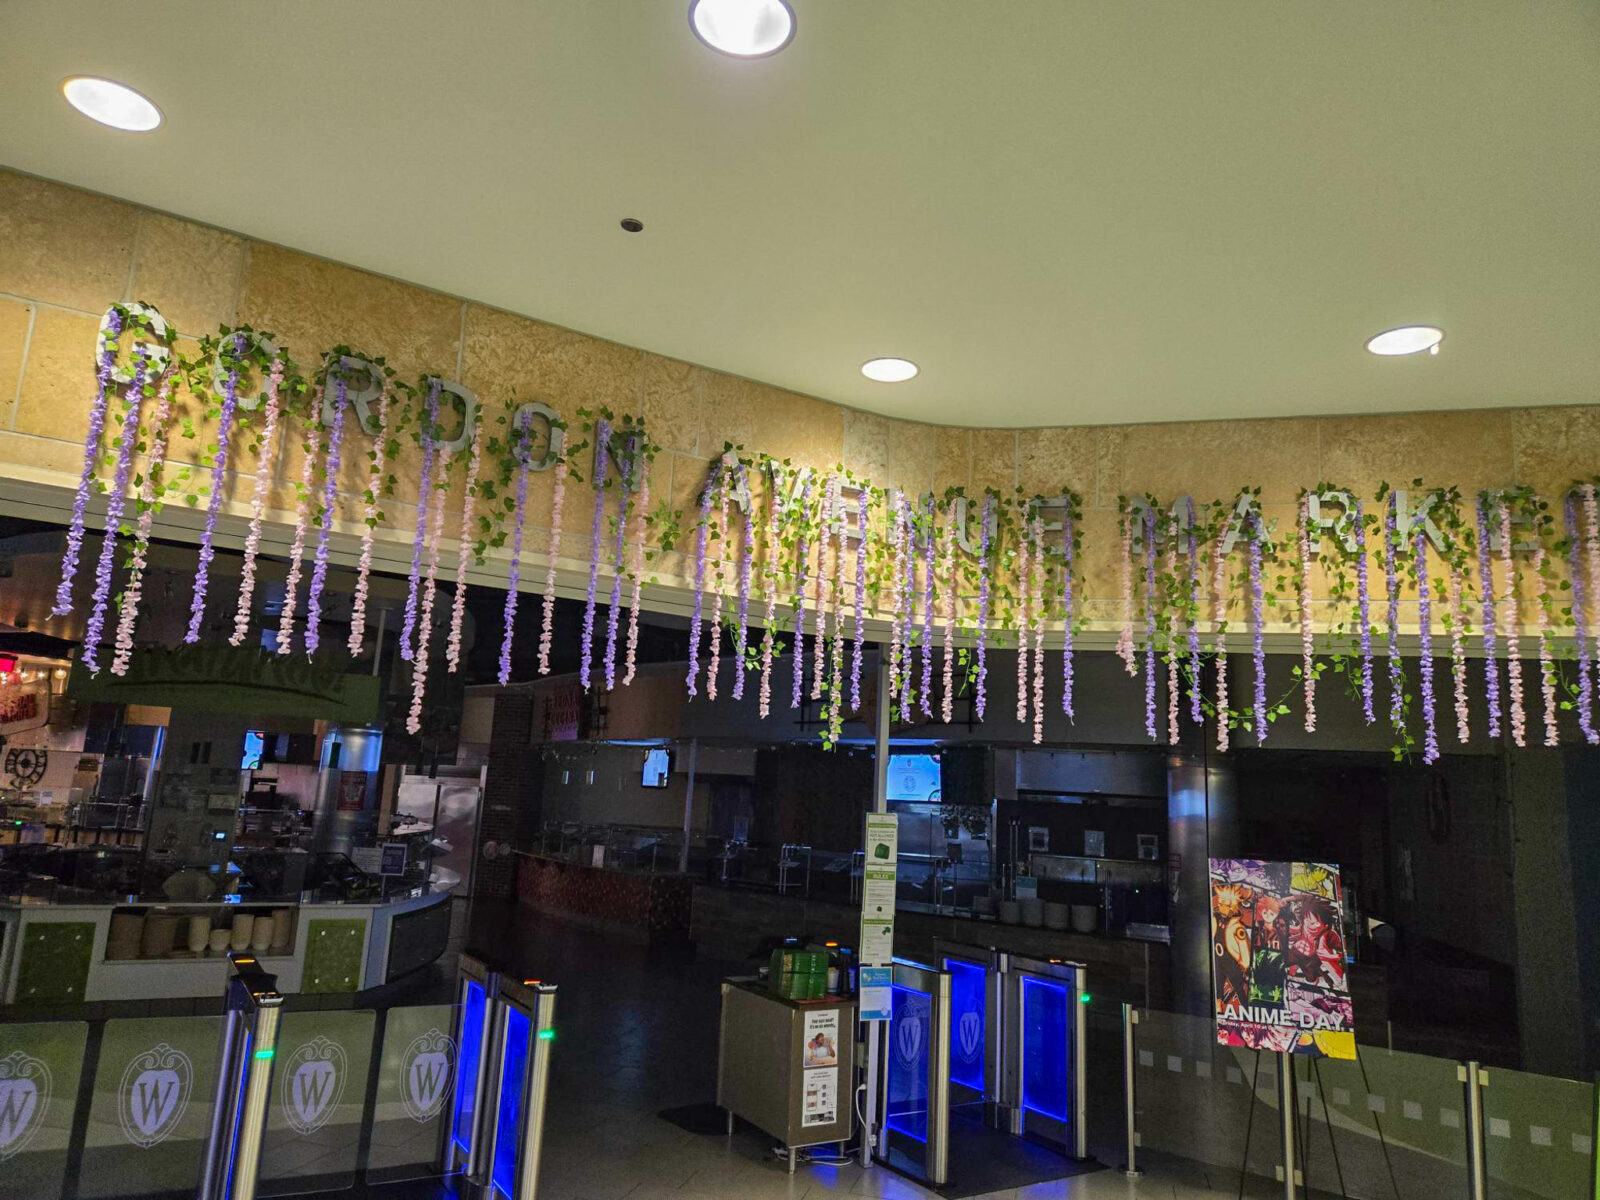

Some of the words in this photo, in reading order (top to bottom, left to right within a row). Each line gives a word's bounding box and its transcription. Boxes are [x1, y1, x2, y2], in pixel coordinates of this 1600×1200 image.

[96, 302, 646, 492] GORDON
[702, 450, 1071, 555] AVENUE
[902, 1023, 919, 1055] W
[962, 1019, 978, 1049] W
[1224, 1006, 1293, 1026] ANIME
[1300, 1010, 1345, 1031] DAY
[138, 1079, 175, 1126] W
[299, 1069, 332, 1114] W
[415, 1060, 445, 1103] W
